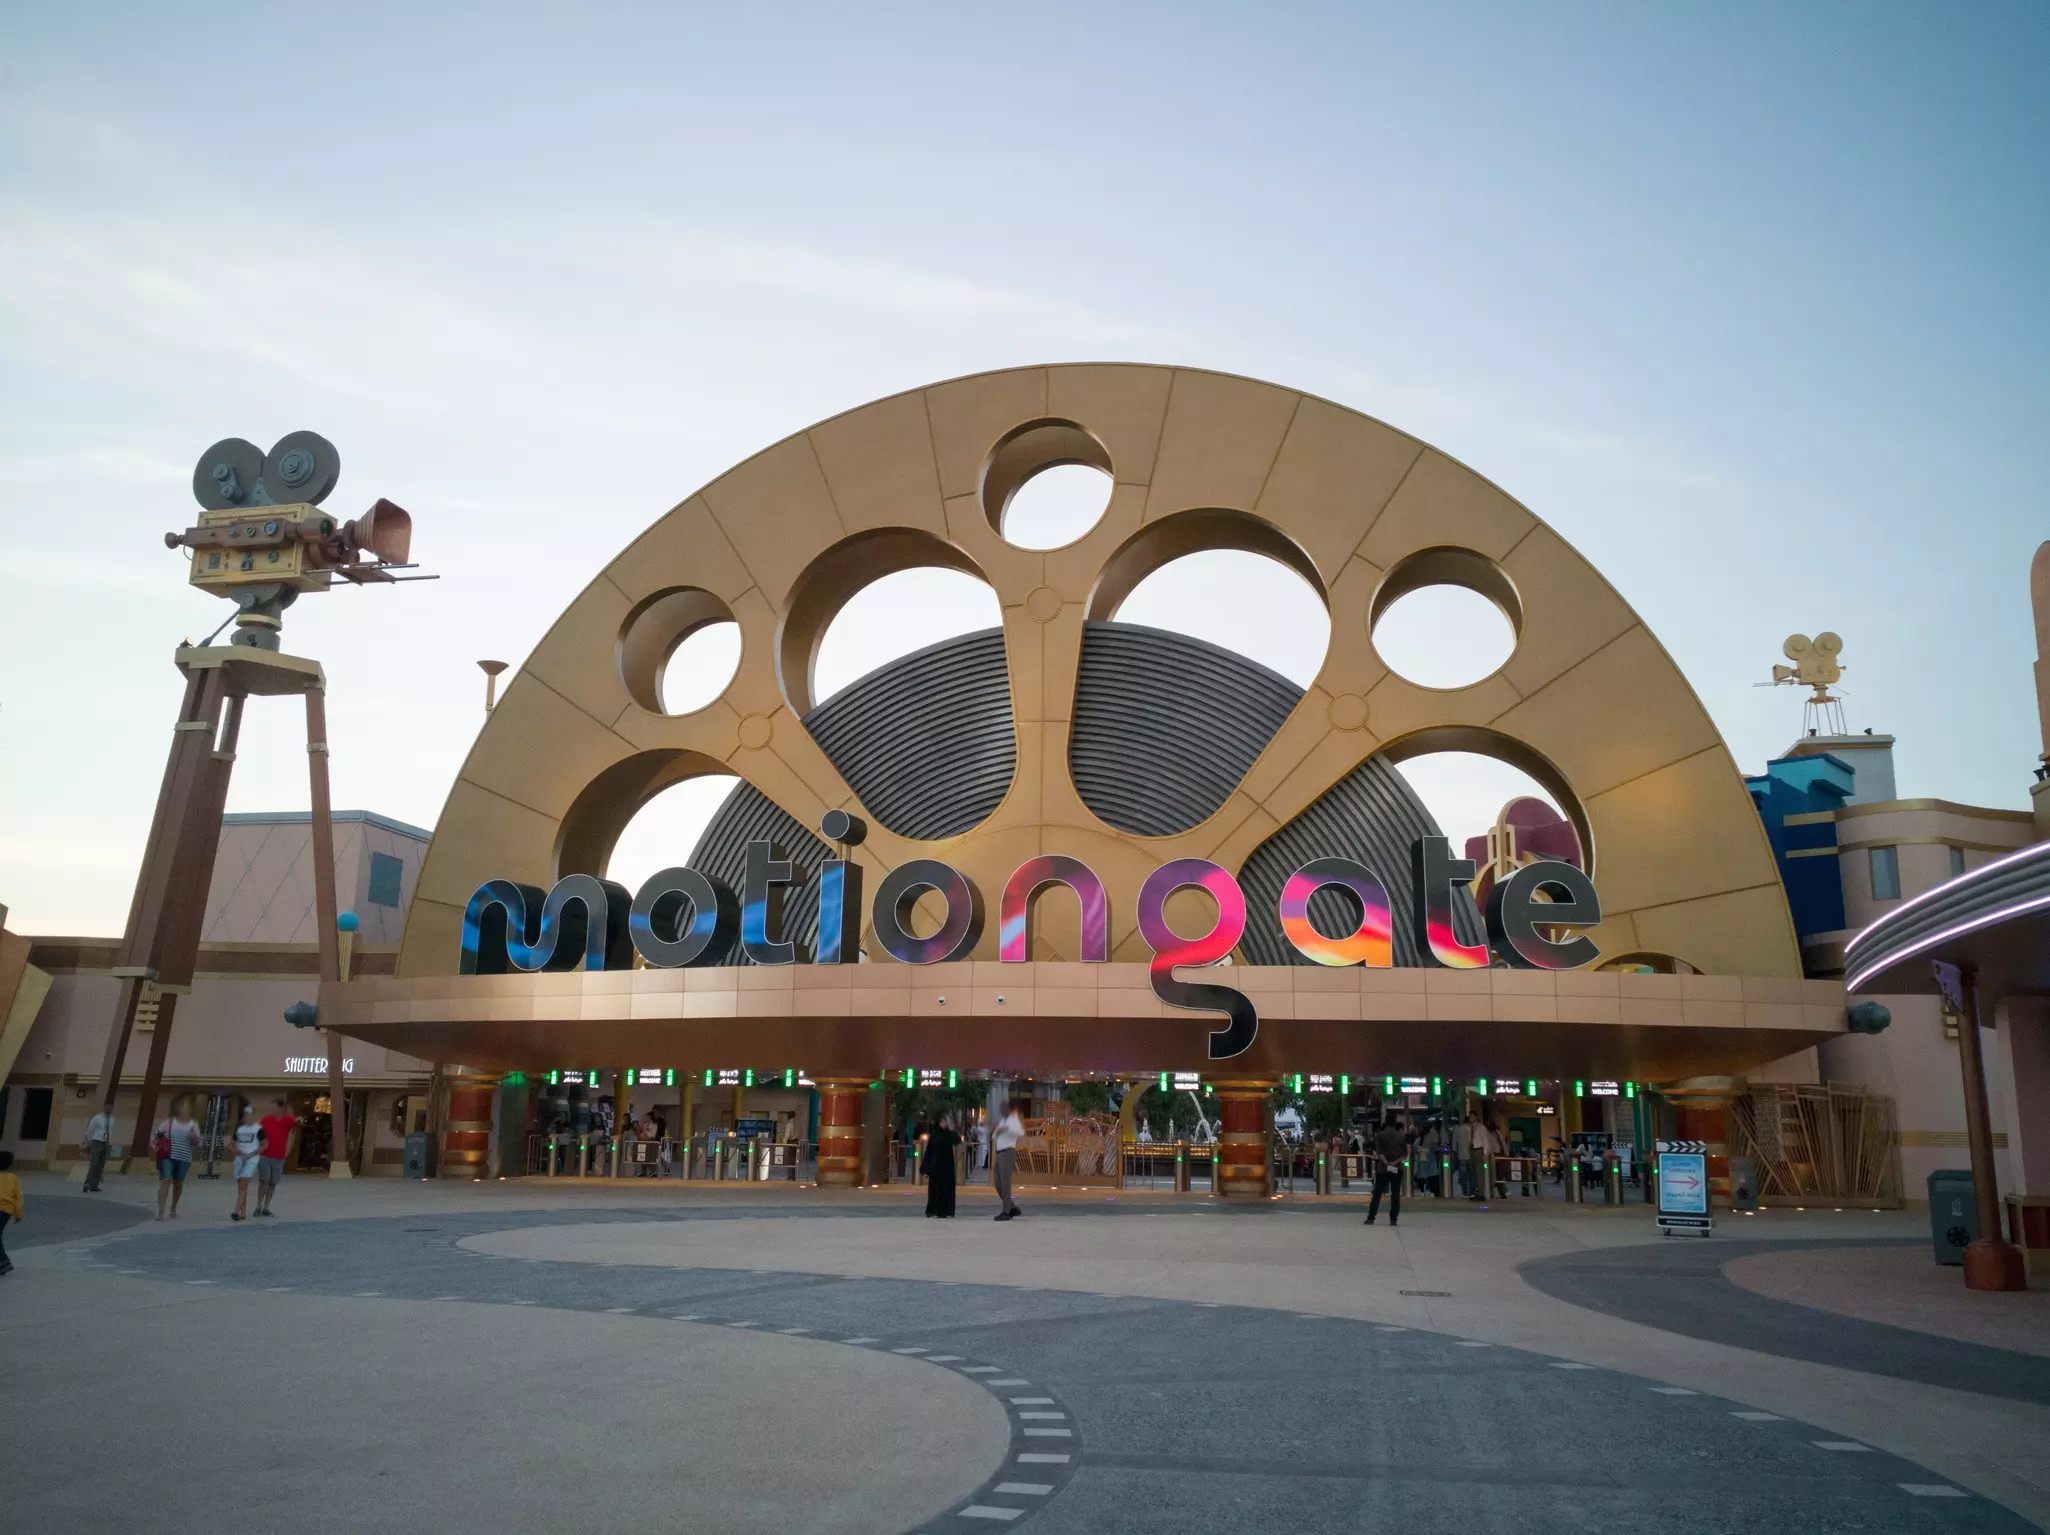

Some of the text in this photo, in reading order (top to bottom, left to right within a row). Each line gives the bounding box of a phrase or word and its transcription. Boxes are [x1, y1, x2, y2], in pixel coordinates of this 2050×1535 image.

[459, 809, 1602, 1060] motiongate
[283, 1057, 354, 1073] SHUTTERG
[1591, 1088, 1619, 1096] WELCOME
